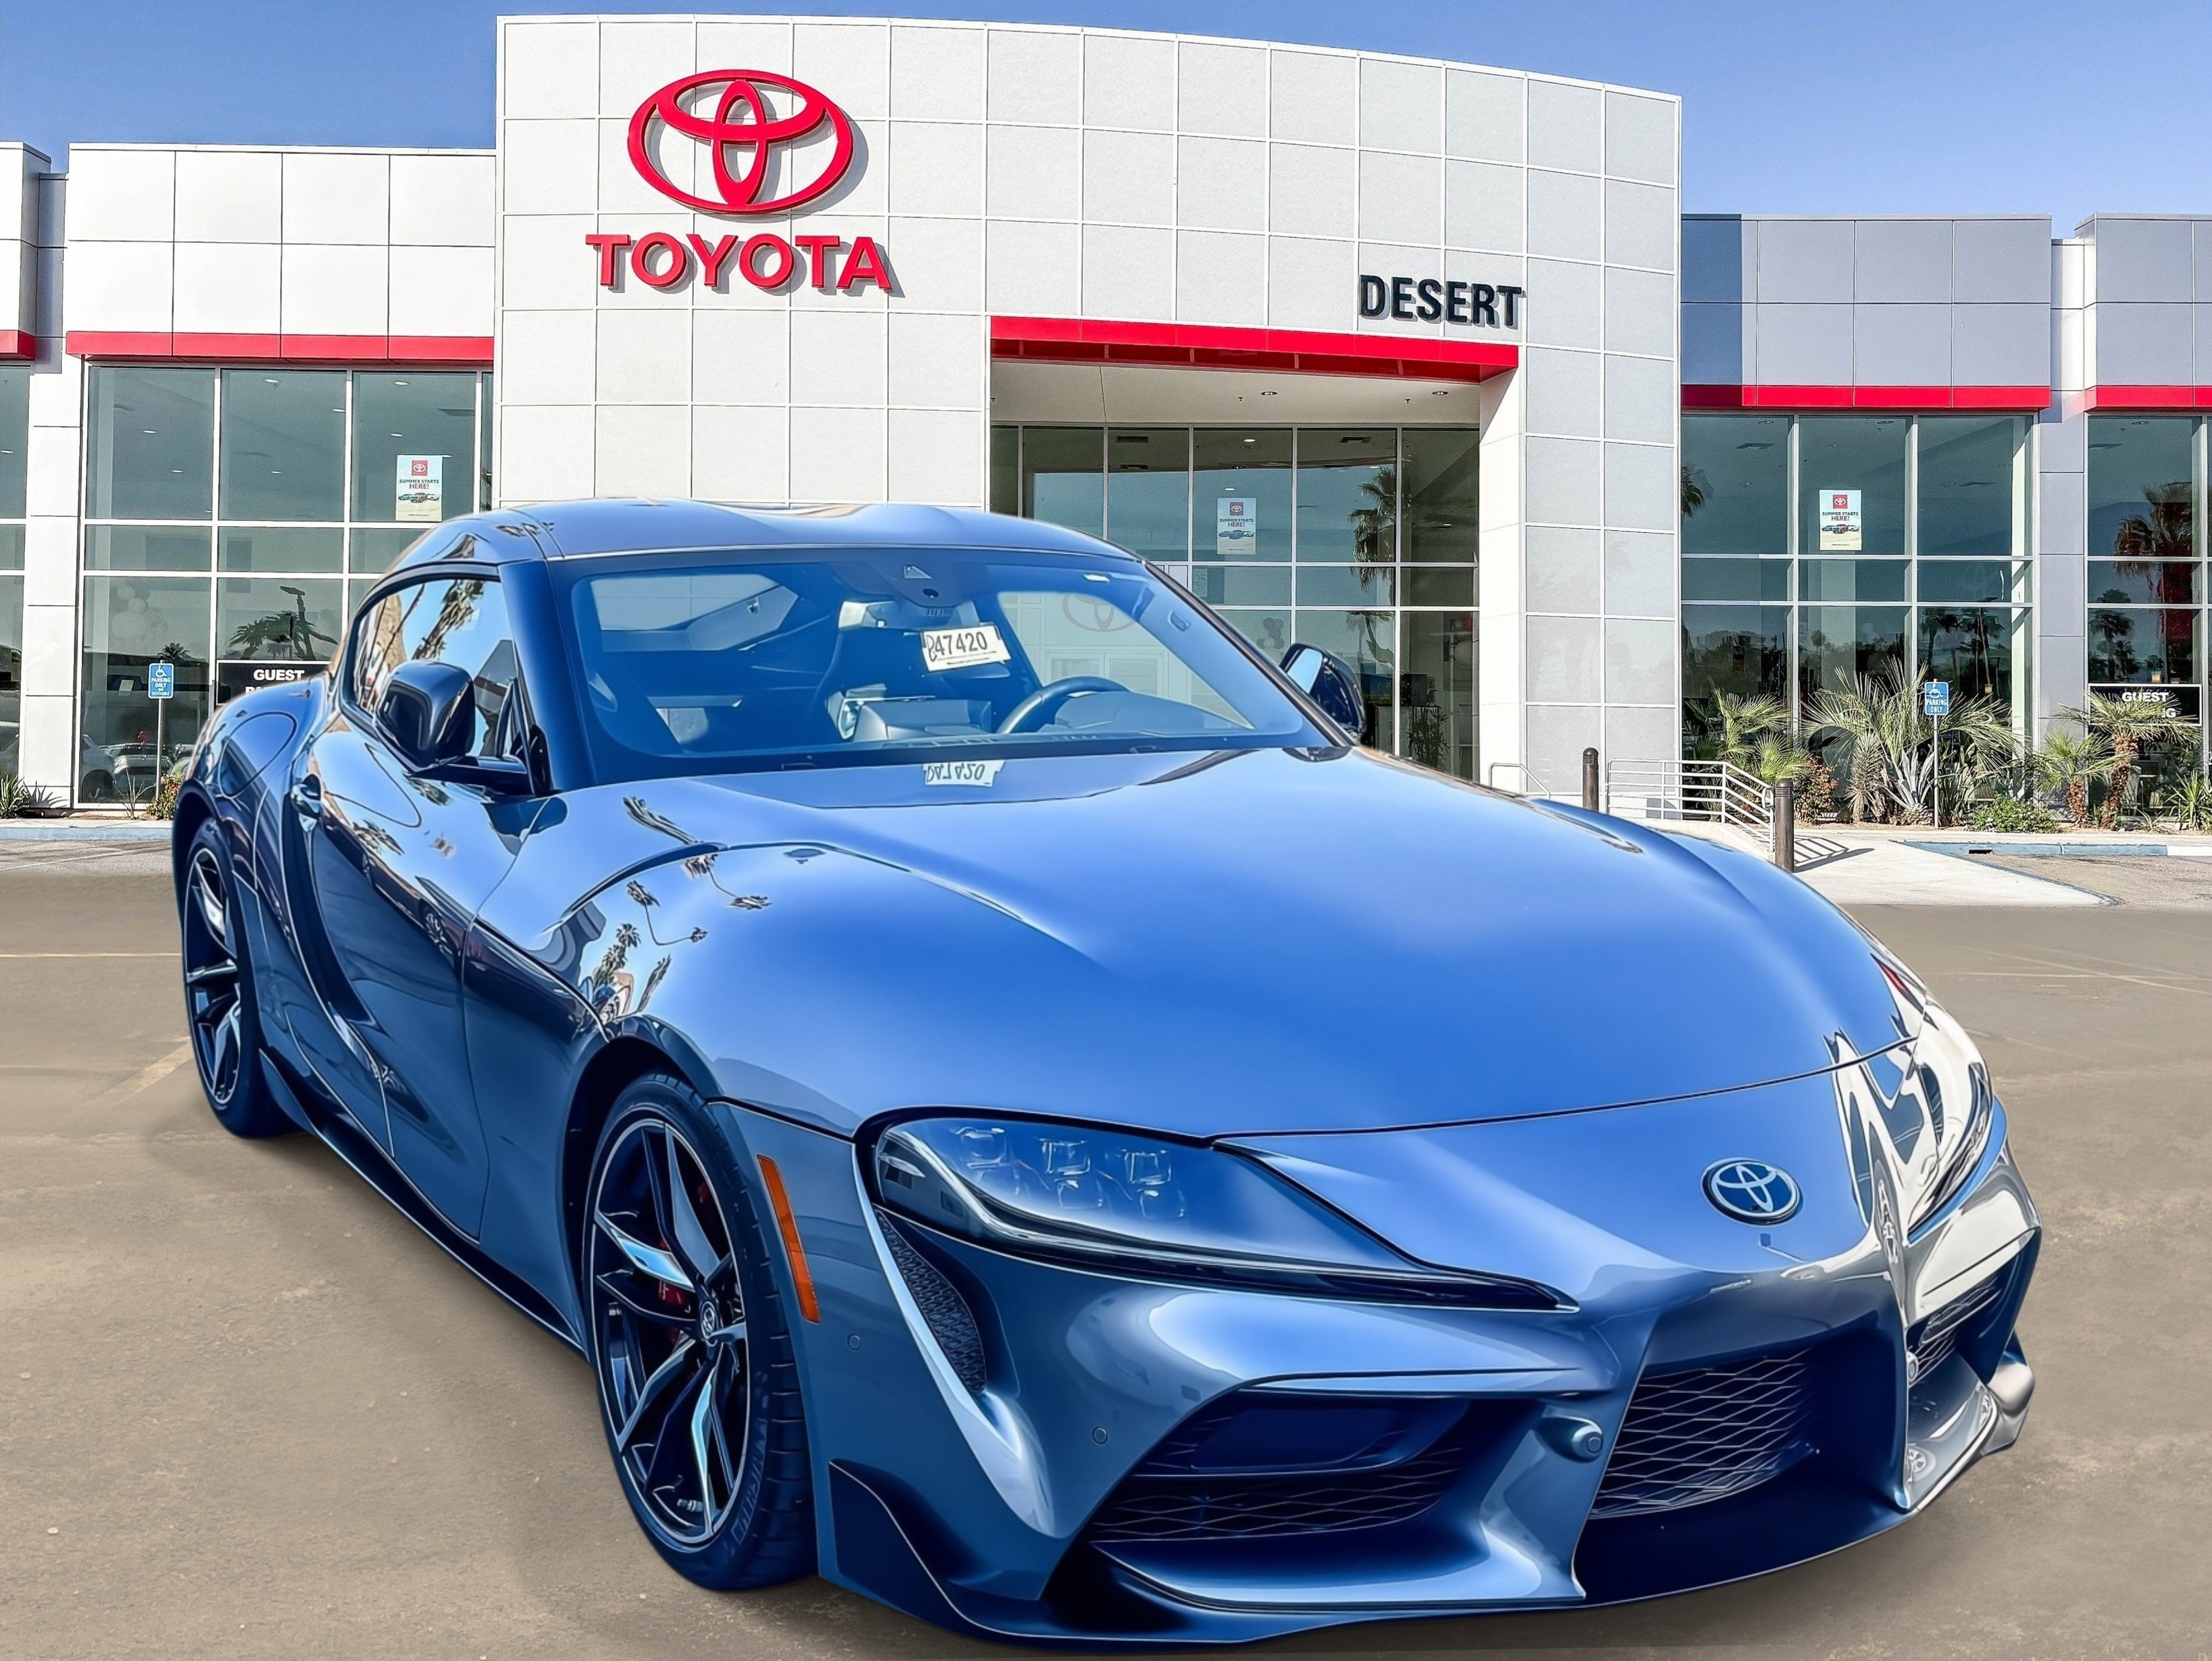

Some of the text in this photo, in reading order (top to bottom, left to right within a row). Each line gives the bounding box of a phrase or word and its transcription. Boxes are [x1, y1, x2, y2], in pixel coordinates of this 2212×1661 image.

[585, 232, 893, 291] TOYOTA
[1358, 274, 1523, 327] DESERT
[253, 669, 305, 681] GUEST
[2121, 691, 2169, 703] GUEST
